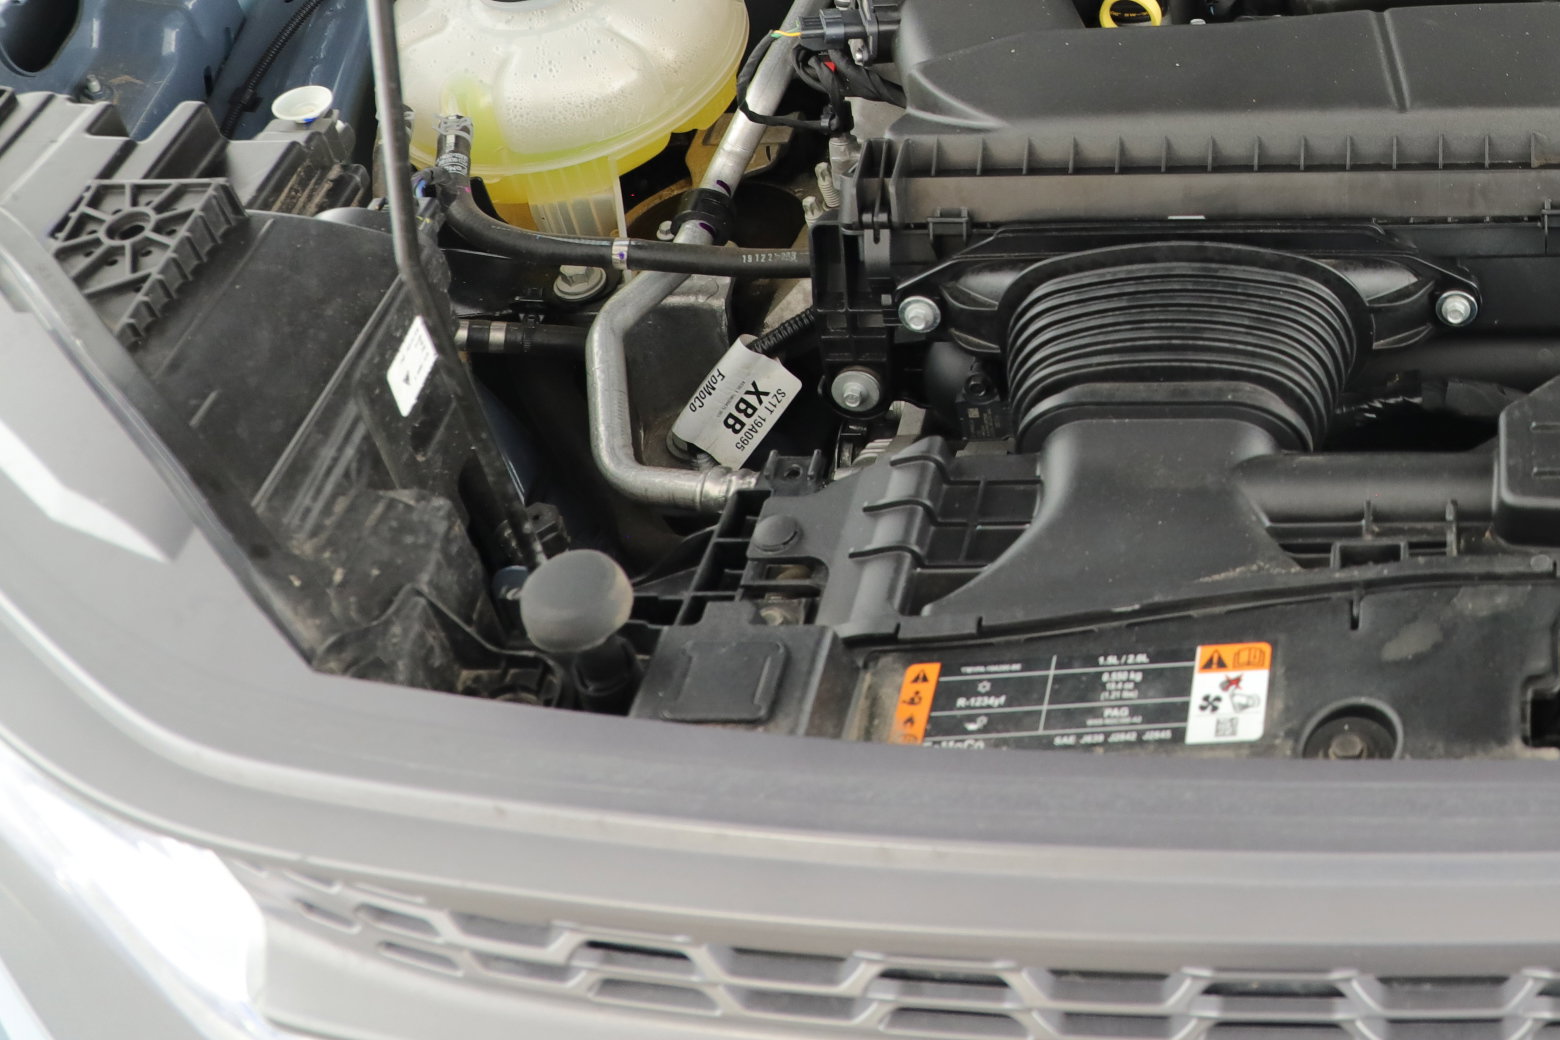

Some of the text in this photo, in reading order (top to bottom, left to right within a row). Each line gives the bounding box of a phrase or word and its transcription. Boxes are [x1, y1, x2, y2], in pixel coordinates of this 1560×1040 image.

[688, 368, 726, 413] FoMoCo
[723, 380, 771, 435] XBB
[735, 388, 787, 452] SZ1T 19A095
[956, 695, 1006, 708] R-1234yf
[1103, 706, 1129, 718] PAG
[1053, 734, 1077, 746] SAE
